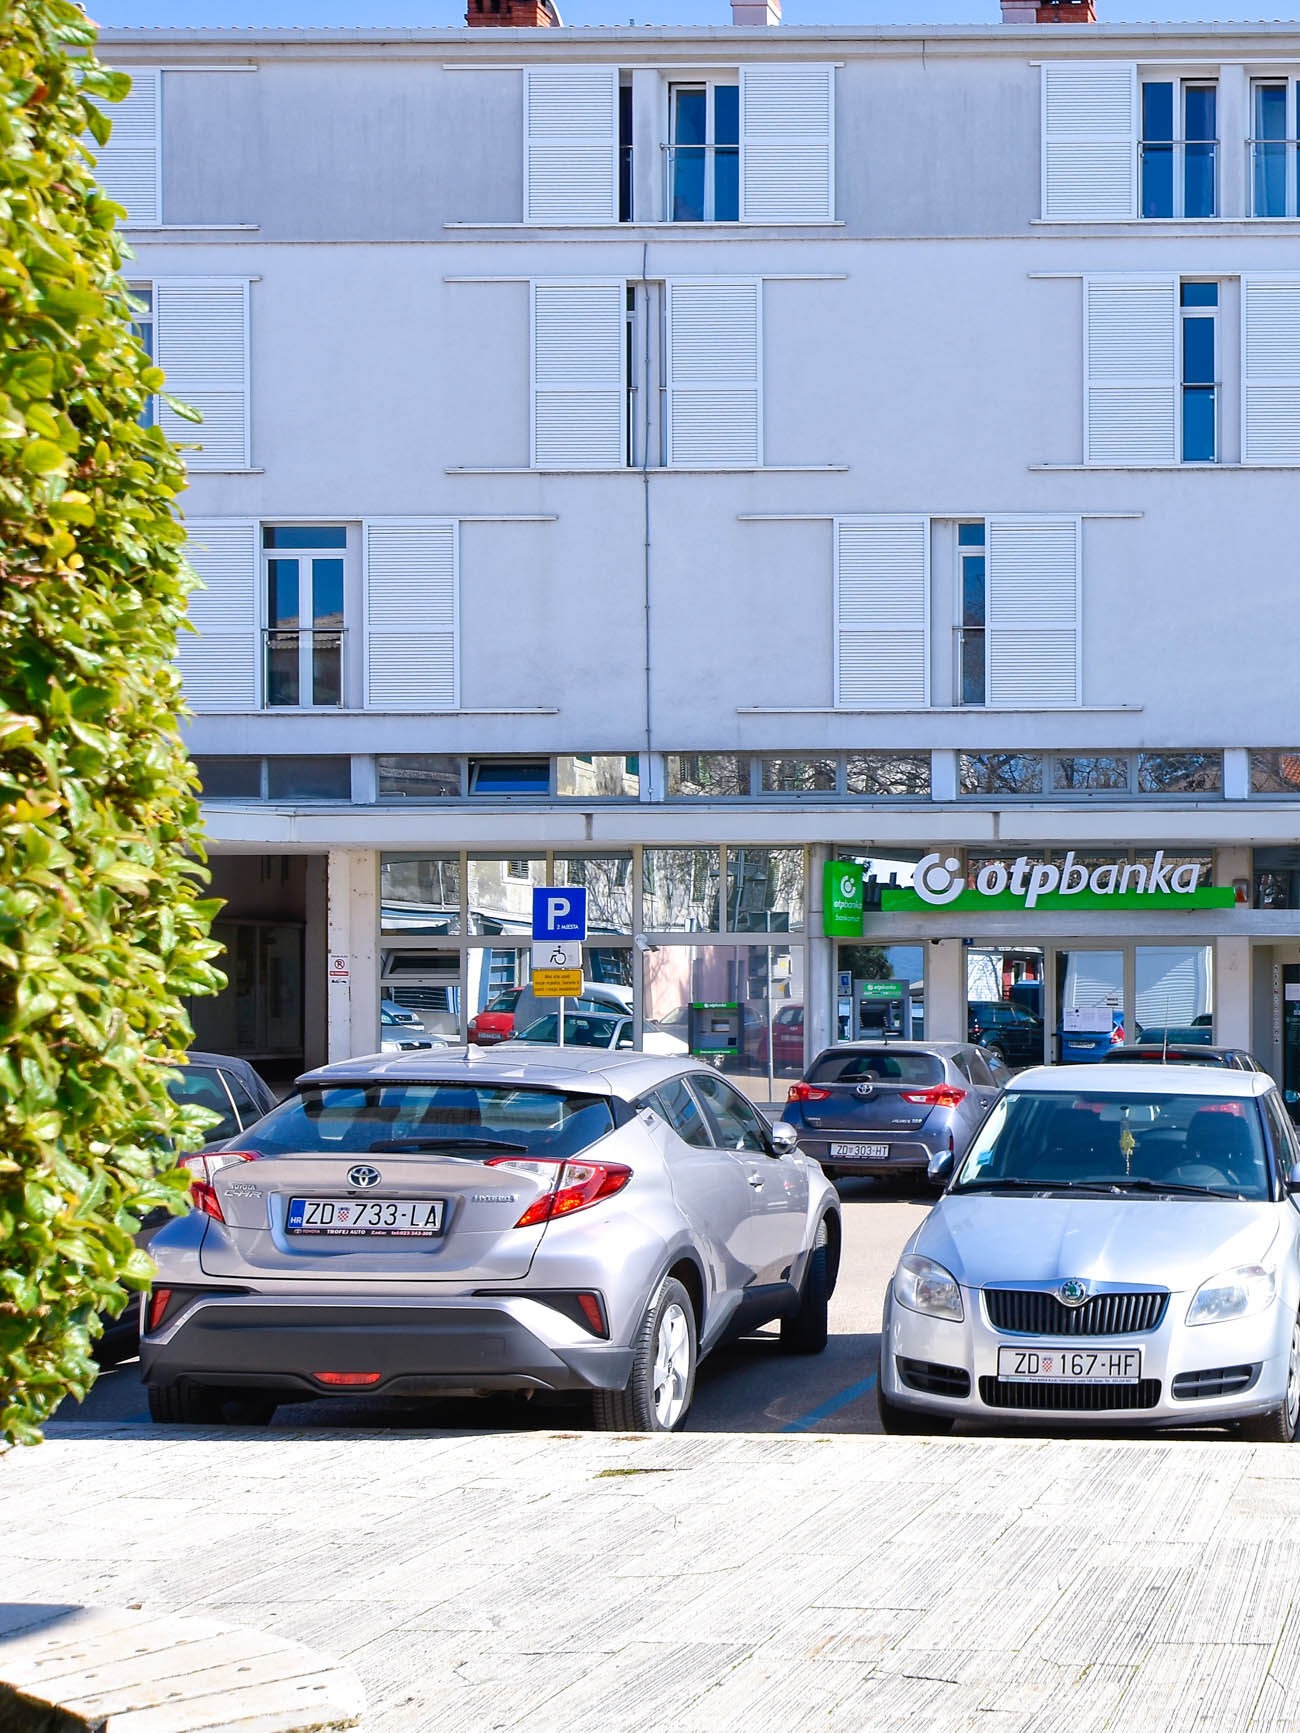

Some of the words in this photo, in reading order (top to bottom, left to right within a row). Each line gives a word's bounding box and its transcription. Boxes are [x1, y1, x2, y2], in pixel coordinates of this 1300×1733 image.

[976, 850, 1201, 908] otpbanka
[547, 897, 571, 931] P
[837, 1145, 848, 1155] ZD
[854, 1145, 888, 1156] 303-HT
[290, 1216, 303, 1224] HR
[305, 1202, 336, 1225] ZD
[352, 1203, 438, 1227] 733-LA
[1014, 1352, 1040, 1375] ZD
[1060, 1353, 1136, 1376] 167-HF
